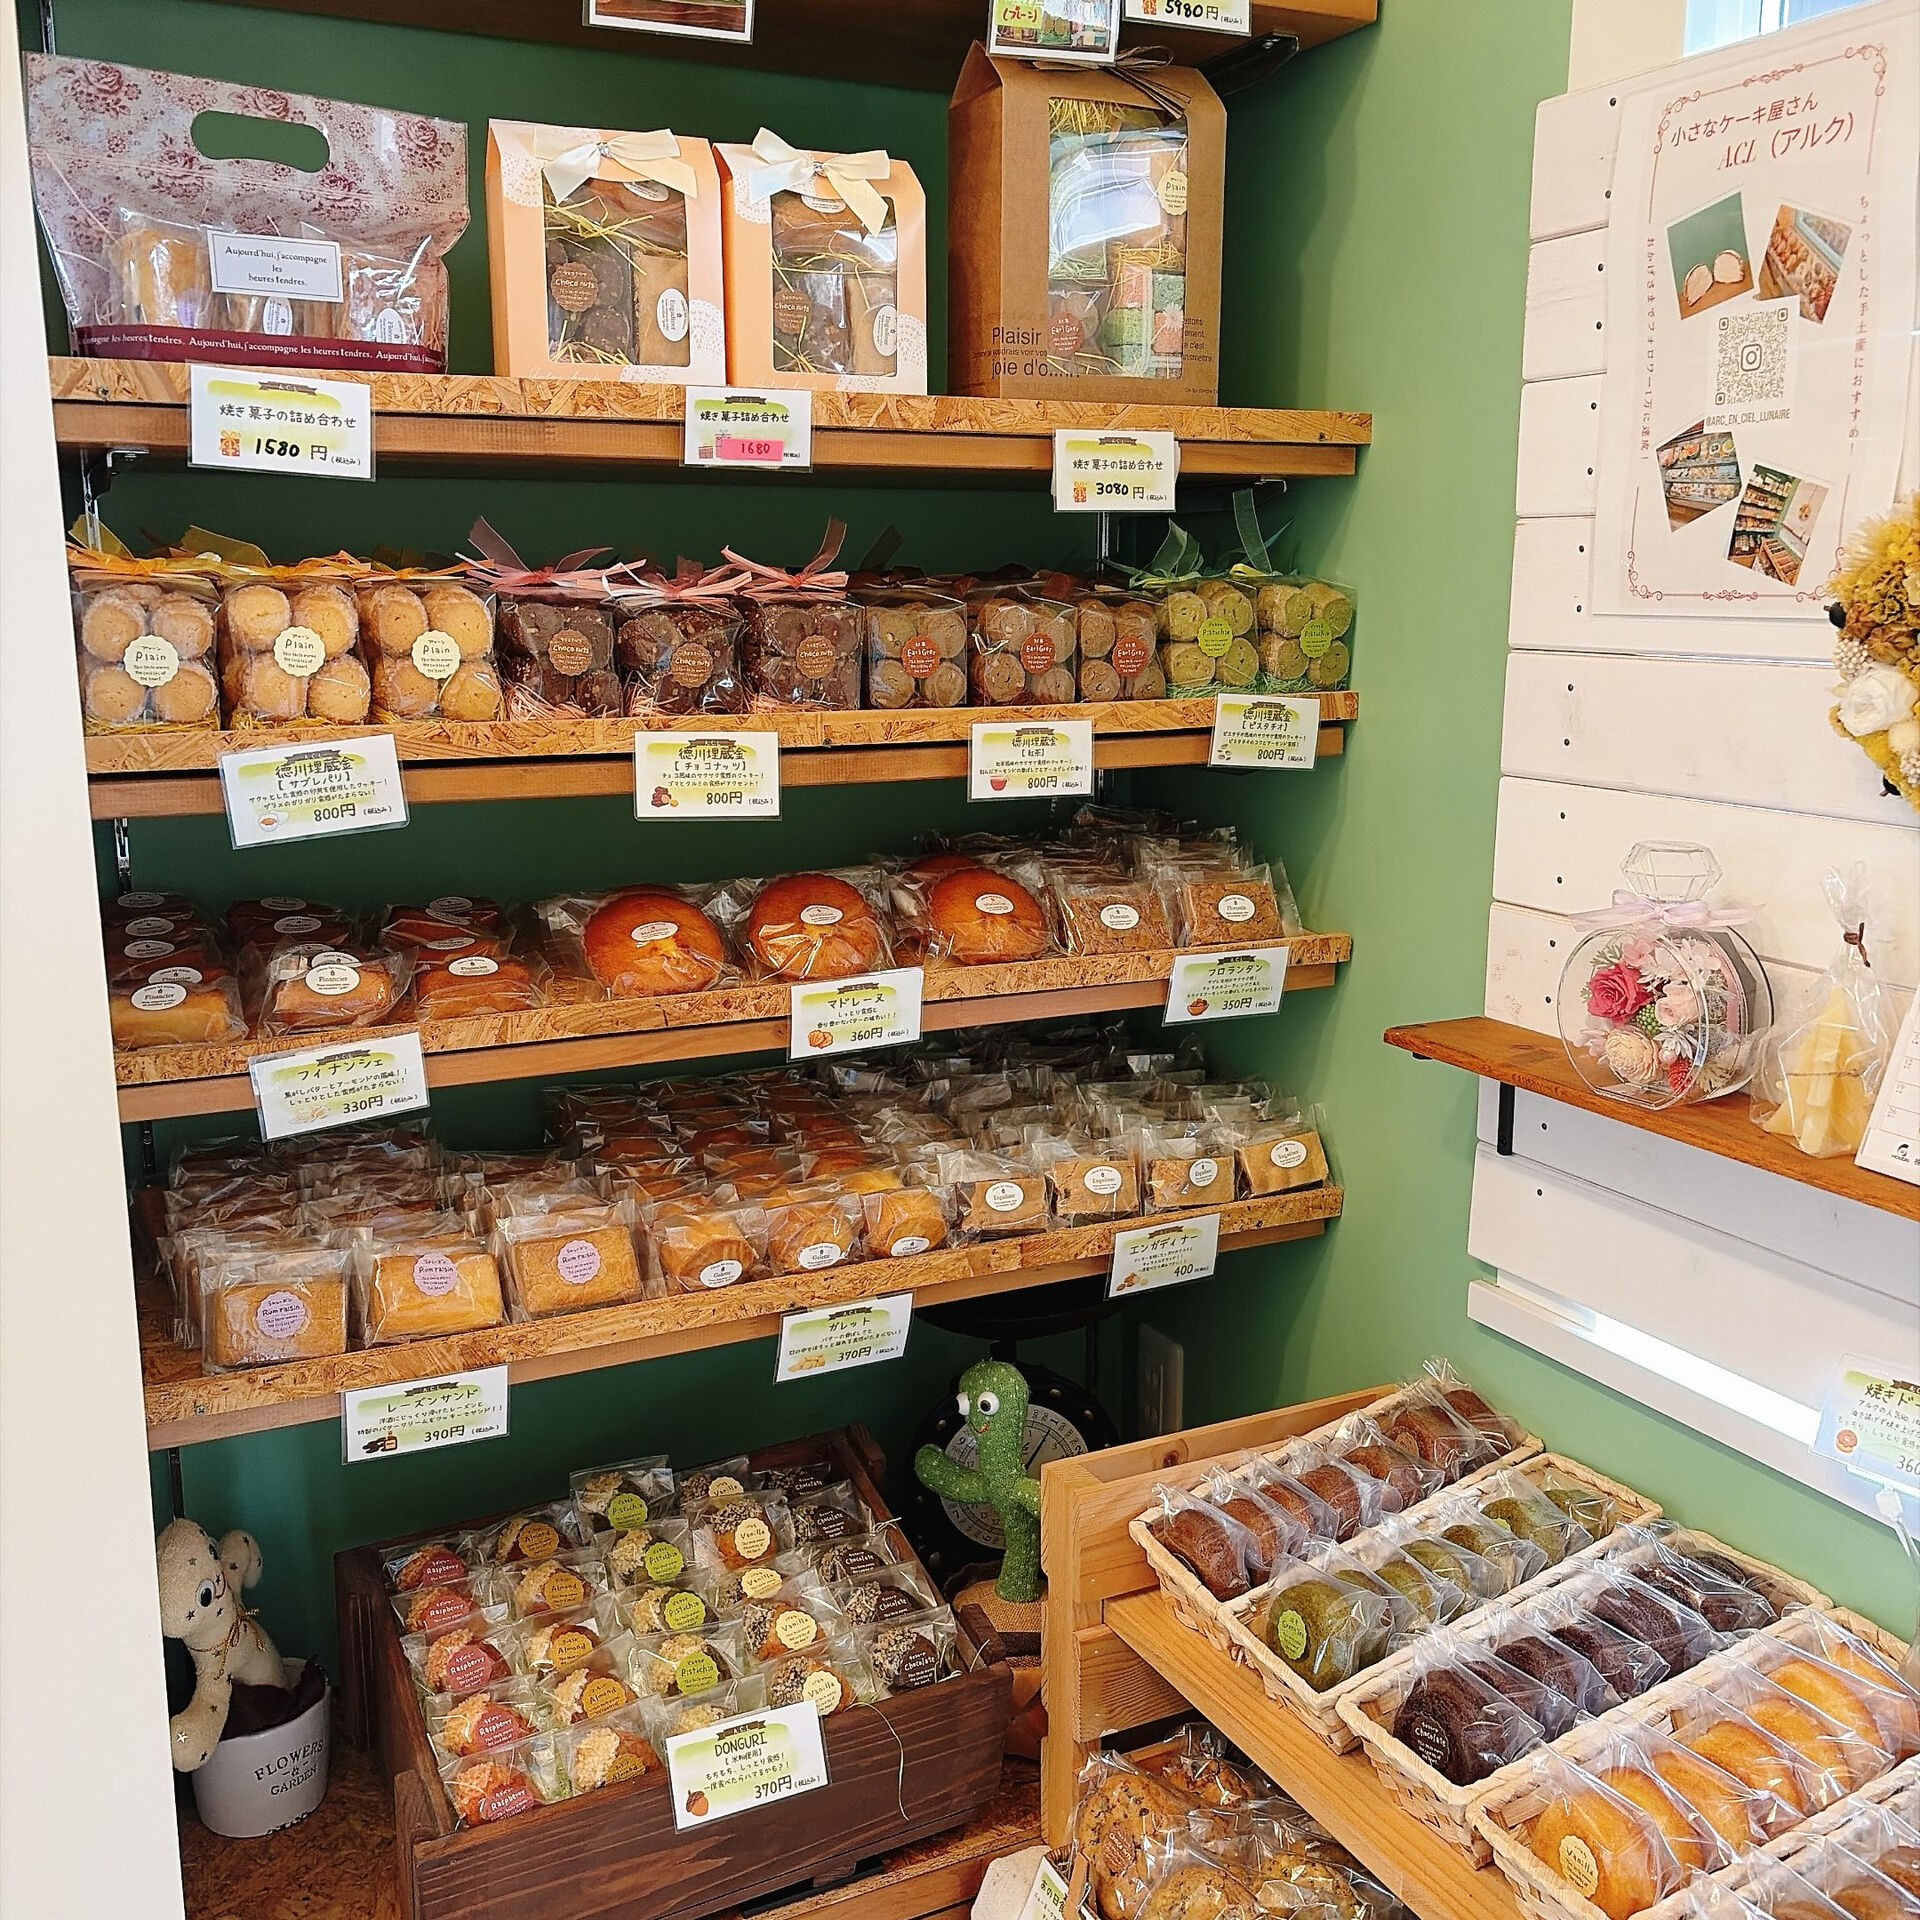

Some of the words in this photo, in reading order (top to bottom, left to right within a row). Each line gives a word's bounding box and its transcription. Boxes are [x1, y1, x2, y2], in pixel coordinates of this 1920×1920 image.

[1165, 0, 1203, 18] 5980
[1206, 6, 1219, 21] 円
[1671, 92, 1818, 147] 小さなケーキ屋さん
[1772, 112, 1853, 158] (アルク)
[1166, 182, 1185, 191] Plain
[248, 273, 274, 283] heures
[992, 327, 1042, 345] Plaisir
[313, 346, 339, 356] heures
[991, 358, 1020, 379] joie
[219, 404, 356, 428] 焼き菓子の詰め合わせ
[700, 410, 790, 422] 焼き菓子詰め合わせ
[255, 438, 300, 458] 1580
[311, 445, 327, 461] 円
[741, 443, 770, 454] 1680
[1073, 459, 1163, 470] 焼き菓子の詰め合わせ
[1096, 482, 1128, 495] 3080
[1133, 487, 1144, 499] 円
[285, 639, 314, 649] Plain
[423, 645, 450, 655] Plain
[136, 652, 166, 662] Plain
[1243, 709, 1292, 722] 徳川埋蔵金
[1242, 722, 1288, 731] 【ピスタチオ】
[1012, 736, 1058, 747] 徳川埋蔵金
[679, 748, 746, 761] 徳川埋蔵金
[1022, 749, 1044, 757] 【紅茶】
[1258, 749, 1285, 760] 800円
[275, 757, 354, 778] 徳川埋蔵金
[1028, 776, 1057, 789] 800円
[706, 791, 742, 804] 800円
[314, 803, 356, 822] 800円
[1209, 964, 1263, 977] フロランタン
[828, 993, 885, 1009] マドレーヌ
[1222, 997, 1252, 1010] 350円
[851, 1027, 883, 1042] 360円
[298, 1058, 384, 1081] フィナンシェ
[343, 1095, 383, 1114] 330円
[1129, 1234, 1198, 1255] エンガディナー
[1174, 1264, 1193, 1277] 400
[262, 1307, 277, 1317] Rum
[279, 1304, 300, 1313] raisin
[830, 1318, 870, 1332] ガレット
[838, 1346, 871, 1361] 370円
[388, 1389, 479, 1413] レーズンサンド
[424, 1425, 465, 1442] 390円
[740, 1529, 765, 1539] Vanilla
[427, 1563, 459, 1574] Raspberry
[746, 1573, 774, 1585] Vanilla
[429, 1604, 464, 1617] Raspberry
[880, 1598, 907, 1611] Chocolate
[781, 1617, 809, 1631] Vanilla
[558, 1645, 586, 1654] Almond
[450, 1656, 485, 1675] Raspberry
[904, 1656, 935, 1671] Chocolate
[589, 1686, 616, 1704] Almond
[807, 1681, 835, 1698] Vanilla
[478, 1718, 513, 1736] Raspberry
[714, 1732, 768, 1757] DONGURI
[1415, 1727, 1446, 1747] Chocolate
[254, 1738, 324, 1781] FLOWERS
[270, 1764, 317, 1795] GARDEN
[755, 1775, 792, 1799] 370円
[491, 1790, 525, 1810] Raspberry
[1566, 1847, 1593, 1876] Vanilla
